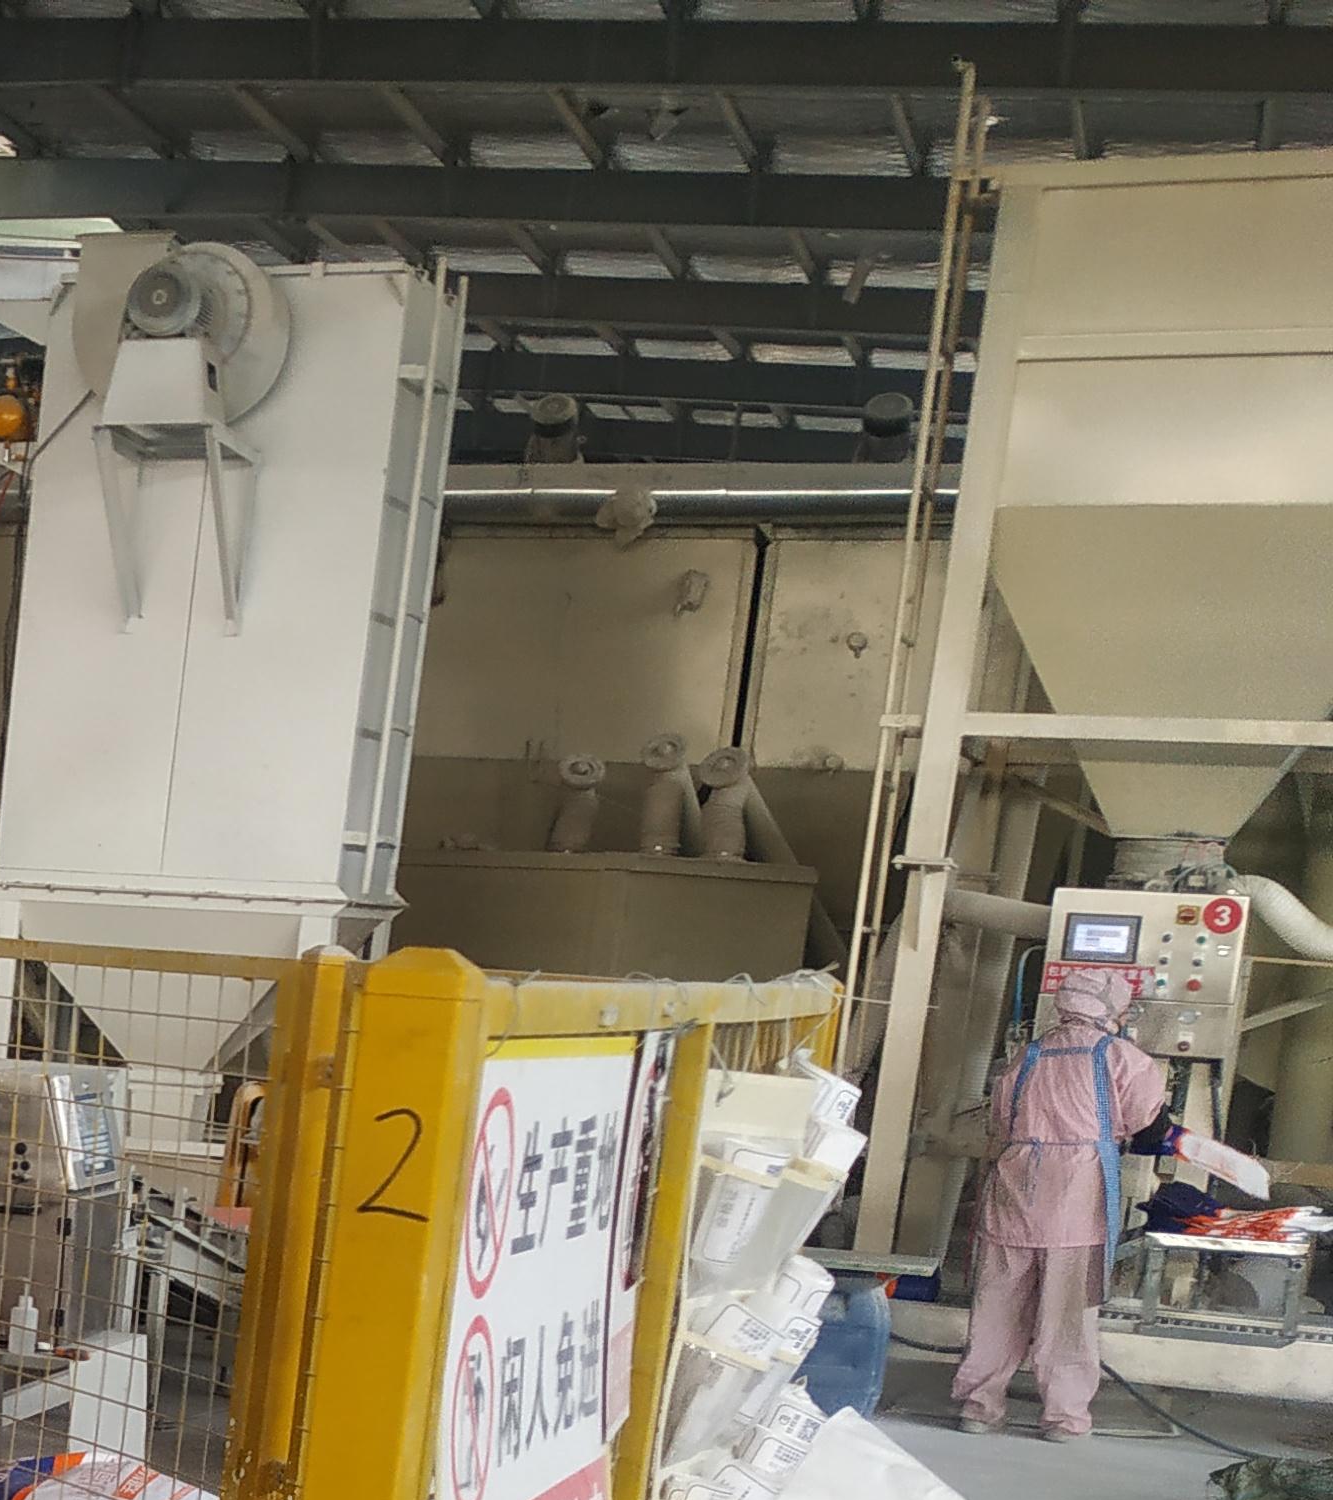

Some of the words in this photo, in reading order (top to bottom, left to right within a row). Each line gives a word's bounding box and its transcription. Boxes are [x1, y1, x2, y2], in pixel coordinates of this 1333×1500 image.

[1212, 905, 1232, 926] 3
[356, 1107, 429, 1222] 2
[510, 1110, 619, 1255] 生产重地
[497, 1300, 601, 1467] 闲人免进
